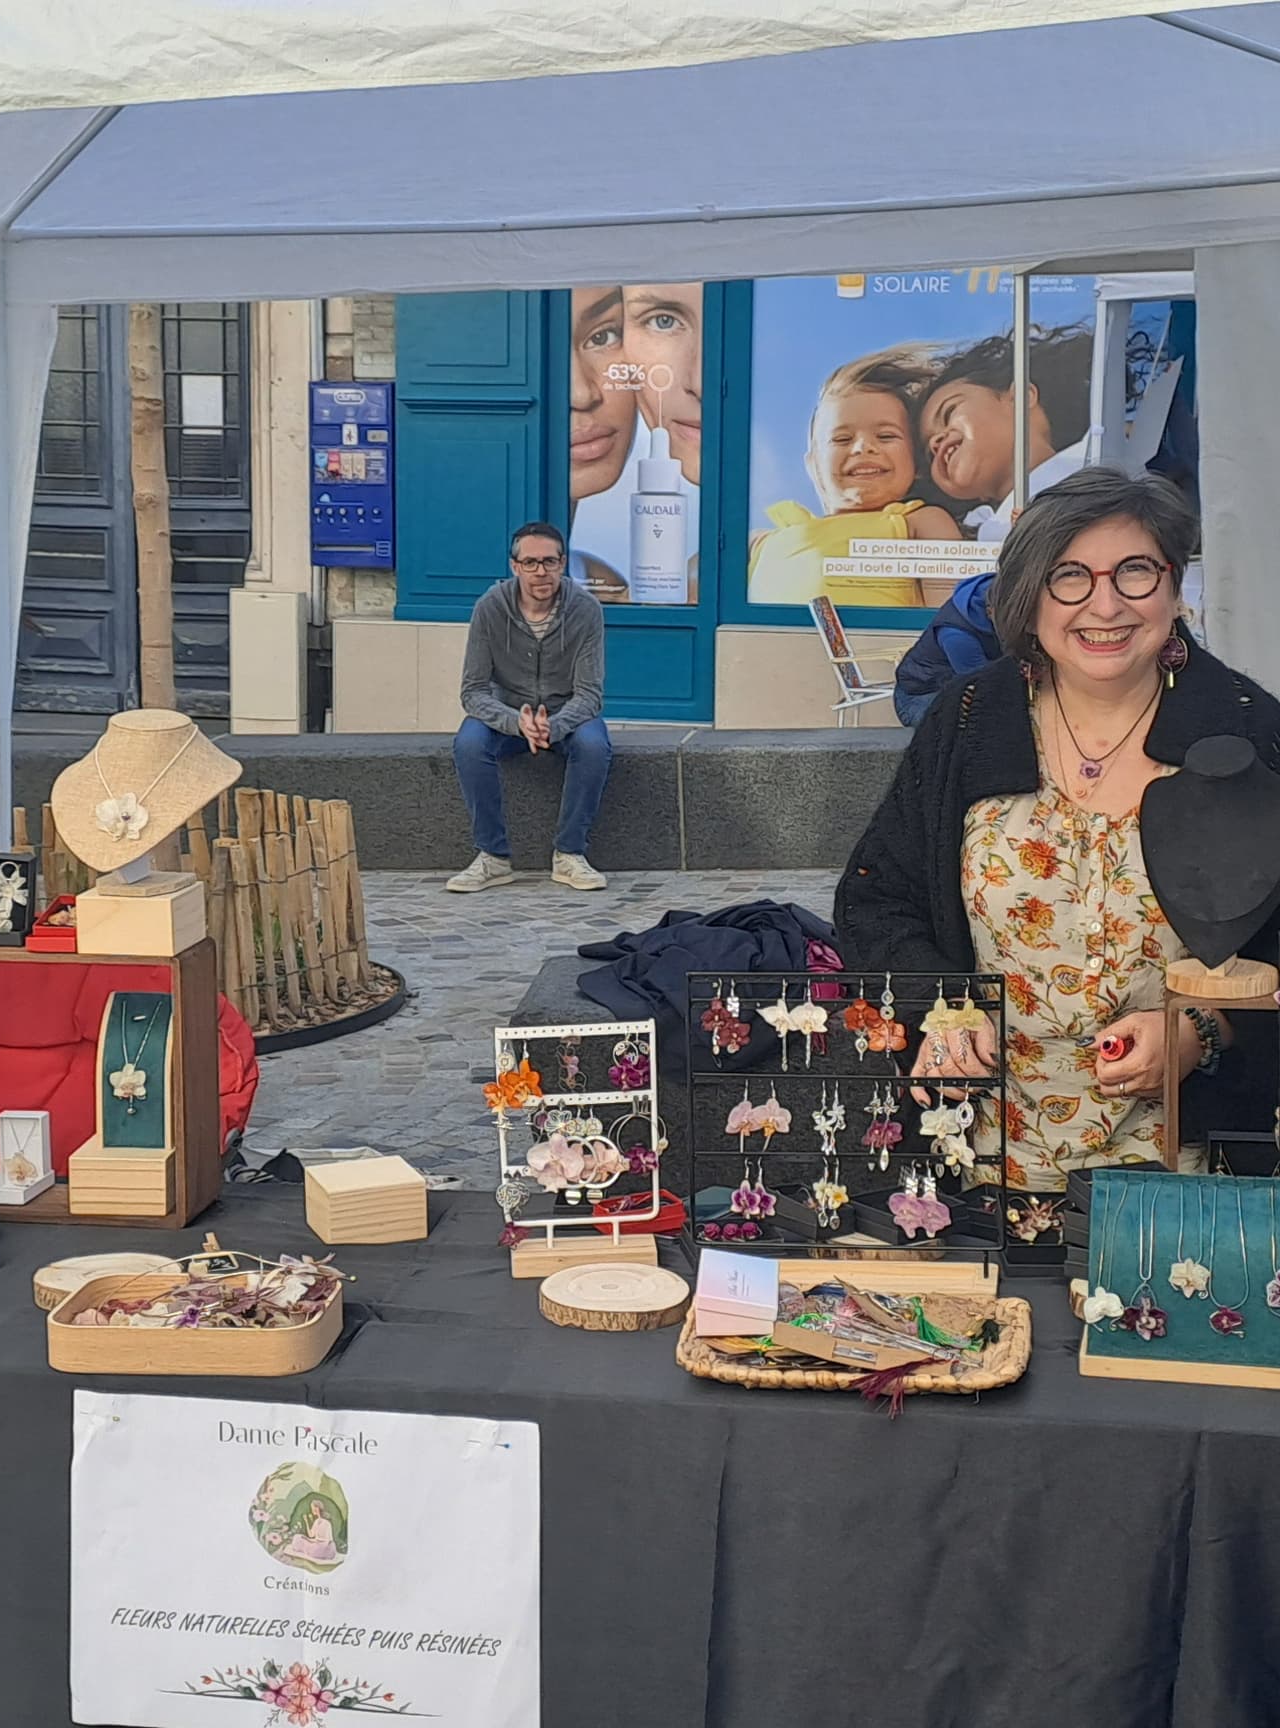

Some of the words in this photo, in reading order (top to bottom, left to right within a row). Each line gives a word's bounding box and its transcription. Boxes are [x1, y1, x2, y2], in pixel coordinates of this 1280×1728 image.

[873, 276, 950, 293] SOLAIRE
[603, 364, 646, 381] -63%
[853, 542, 867, 554] La
[872, 543, 939, 557] protection
[944, 544, 987, 556] solaire
[826, 563, 855, 573] pour
[860, 562, 893, 573] toute
[898, 562, 909, 574] la
[914, 562, 954, 575] famille
[219, 1420, 286, 1448] Dame
[294, 1425, 379, 1456] Pascale
[263, 1575, 331, 1597] Créations
[110, 1607, 178, 1630] FLEURS
[179, 1614, 291, 1639] NATURELLES
[292, 1619, 365, 1648] SÉCHÉES
[368, 1628, 413, 1651] PUIS
[415, 1629, 502, 1658] RÉSINÉES
